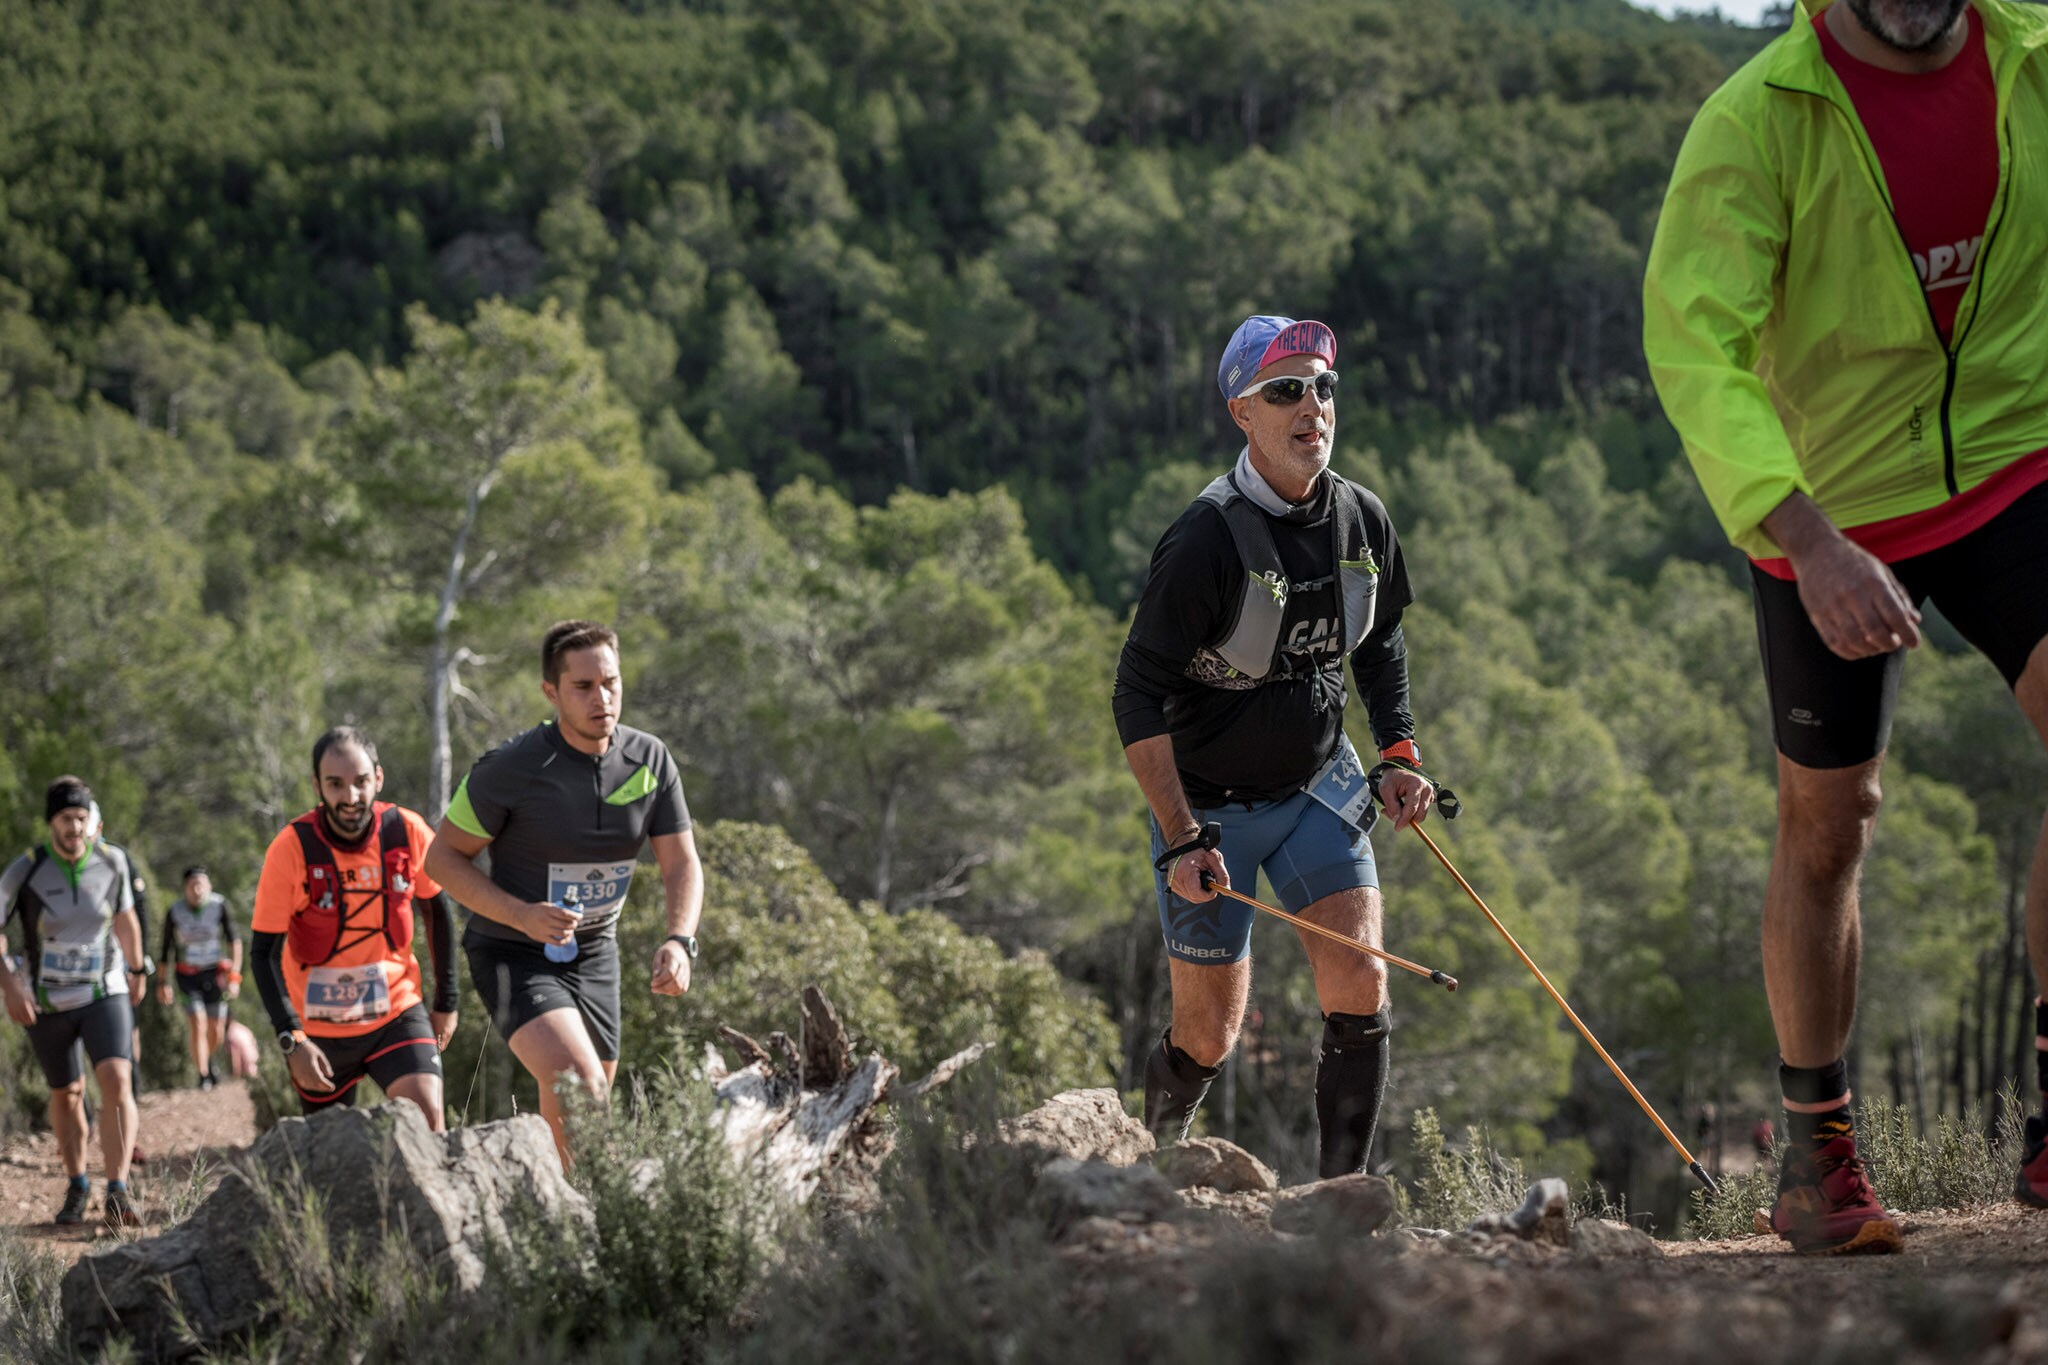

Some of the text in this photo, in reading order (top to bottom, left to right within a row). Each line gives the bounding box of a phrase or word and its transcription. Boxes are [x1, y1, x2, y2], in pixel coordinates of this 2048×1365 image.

[1277, 325, 1298, 352] THE
[573, 882, 617, 901] 330
[1171, 939, 1233, 959] LURBEL
[321, 983, 370, 1002] 1287
